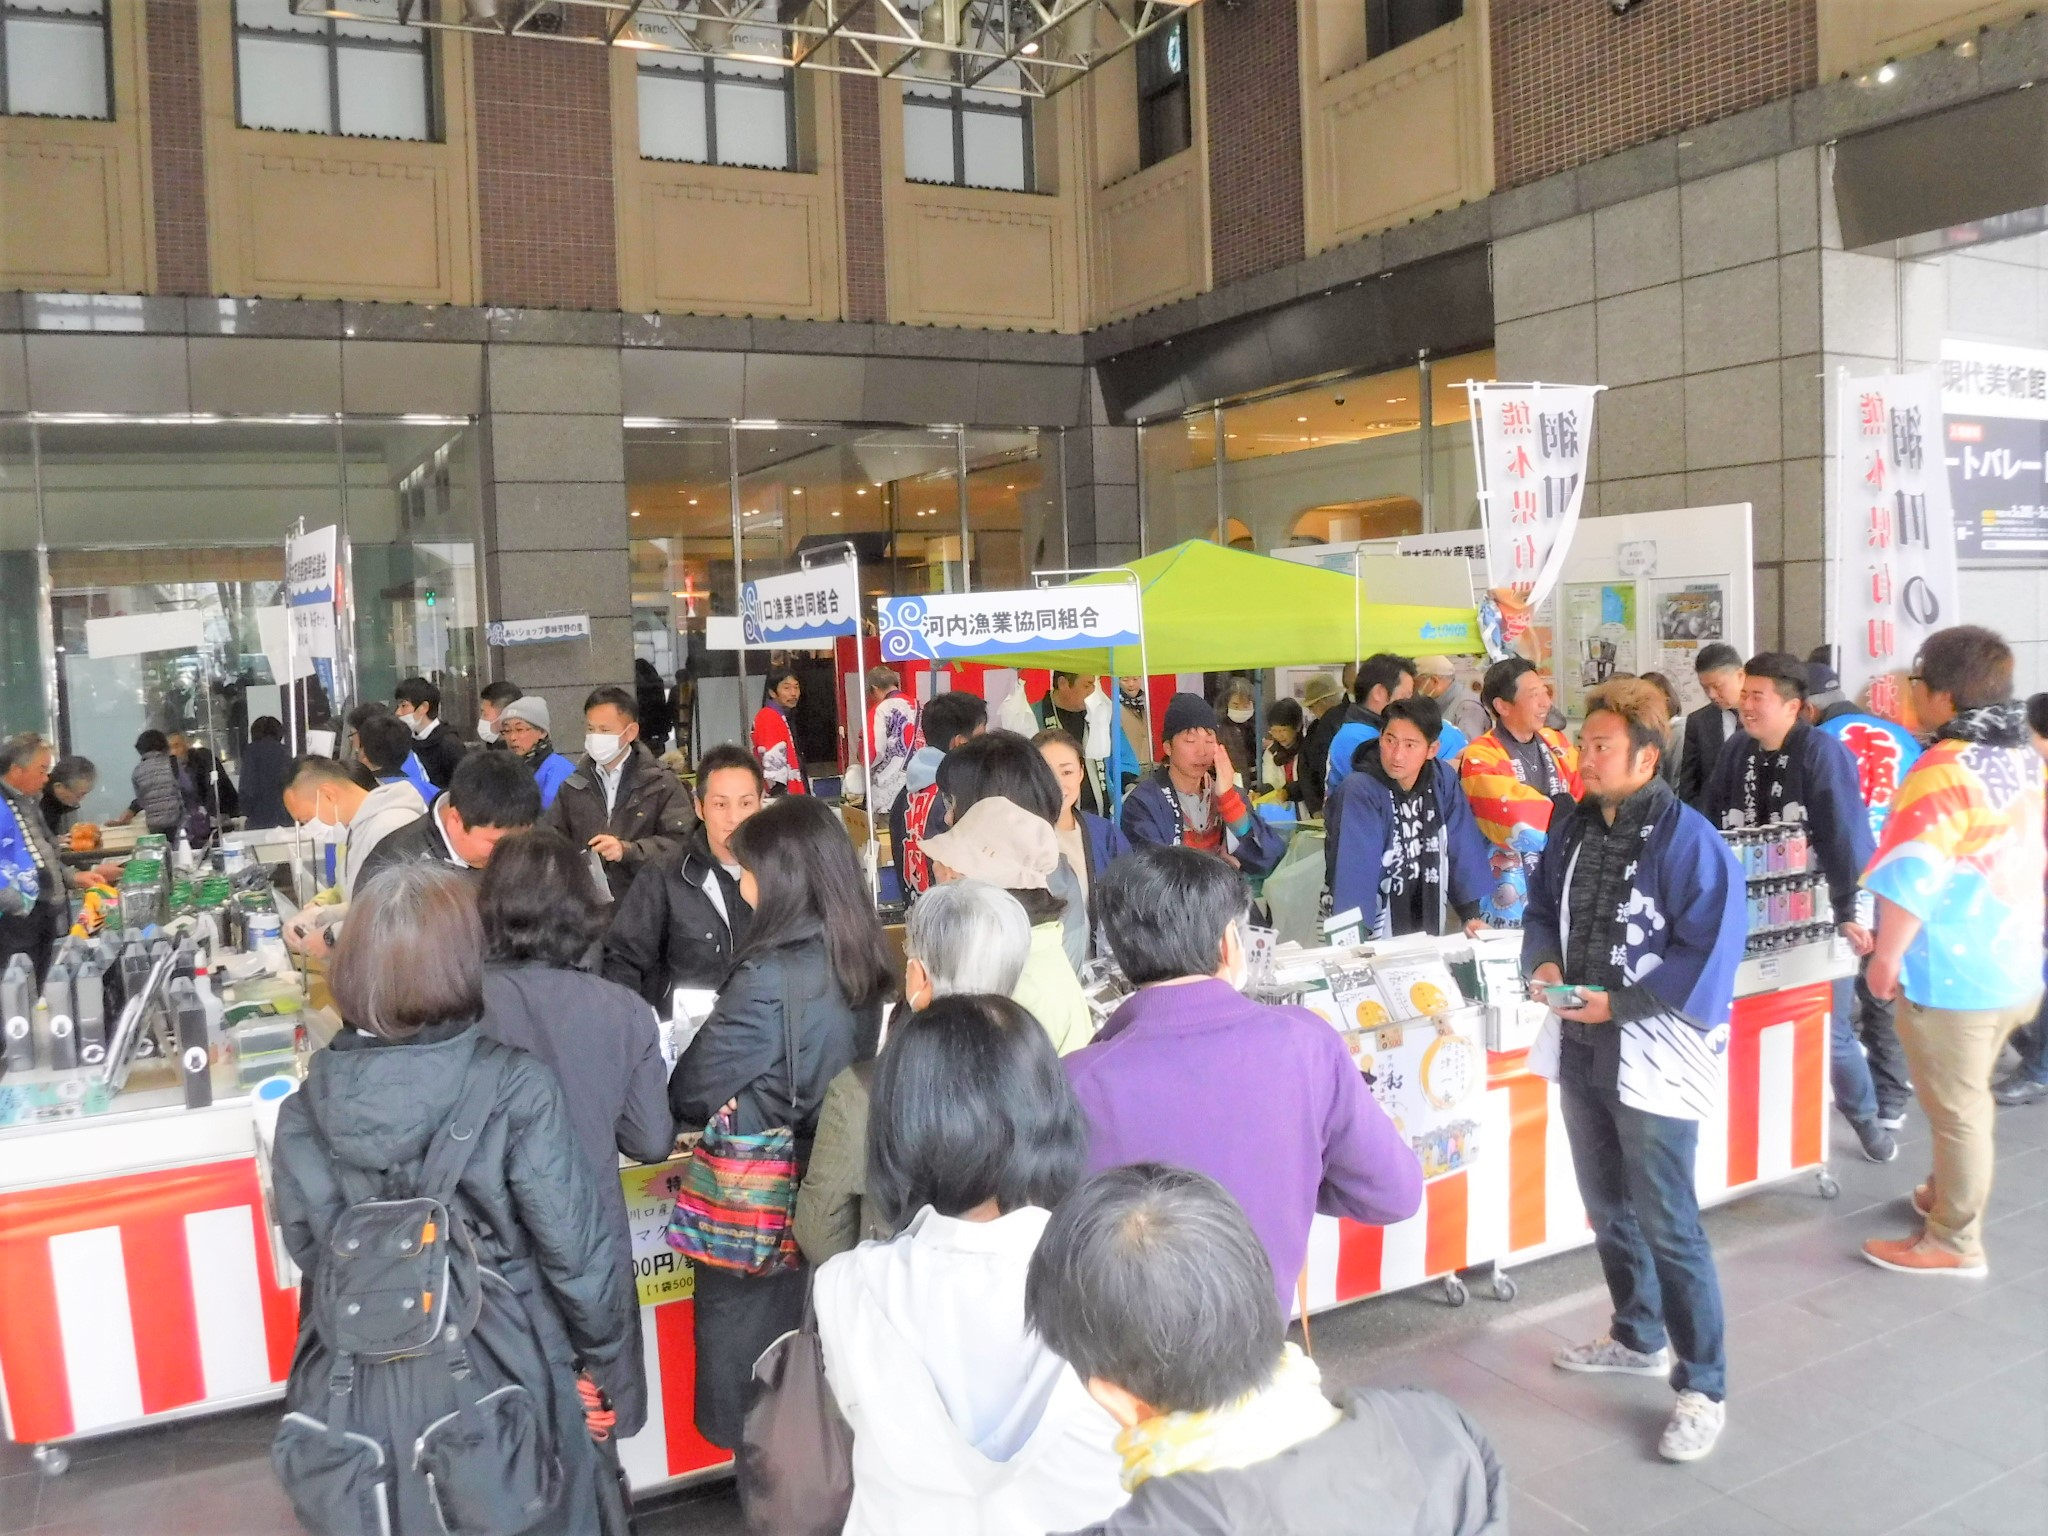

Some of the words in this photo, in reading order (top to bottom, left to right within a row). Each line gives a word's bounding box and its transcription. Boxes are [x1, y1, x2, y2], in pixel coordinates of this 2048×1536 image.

[1942, 445, 2048, 484] ートバレー
[922, 605, 1100, 639] 河内漁業協同組合
